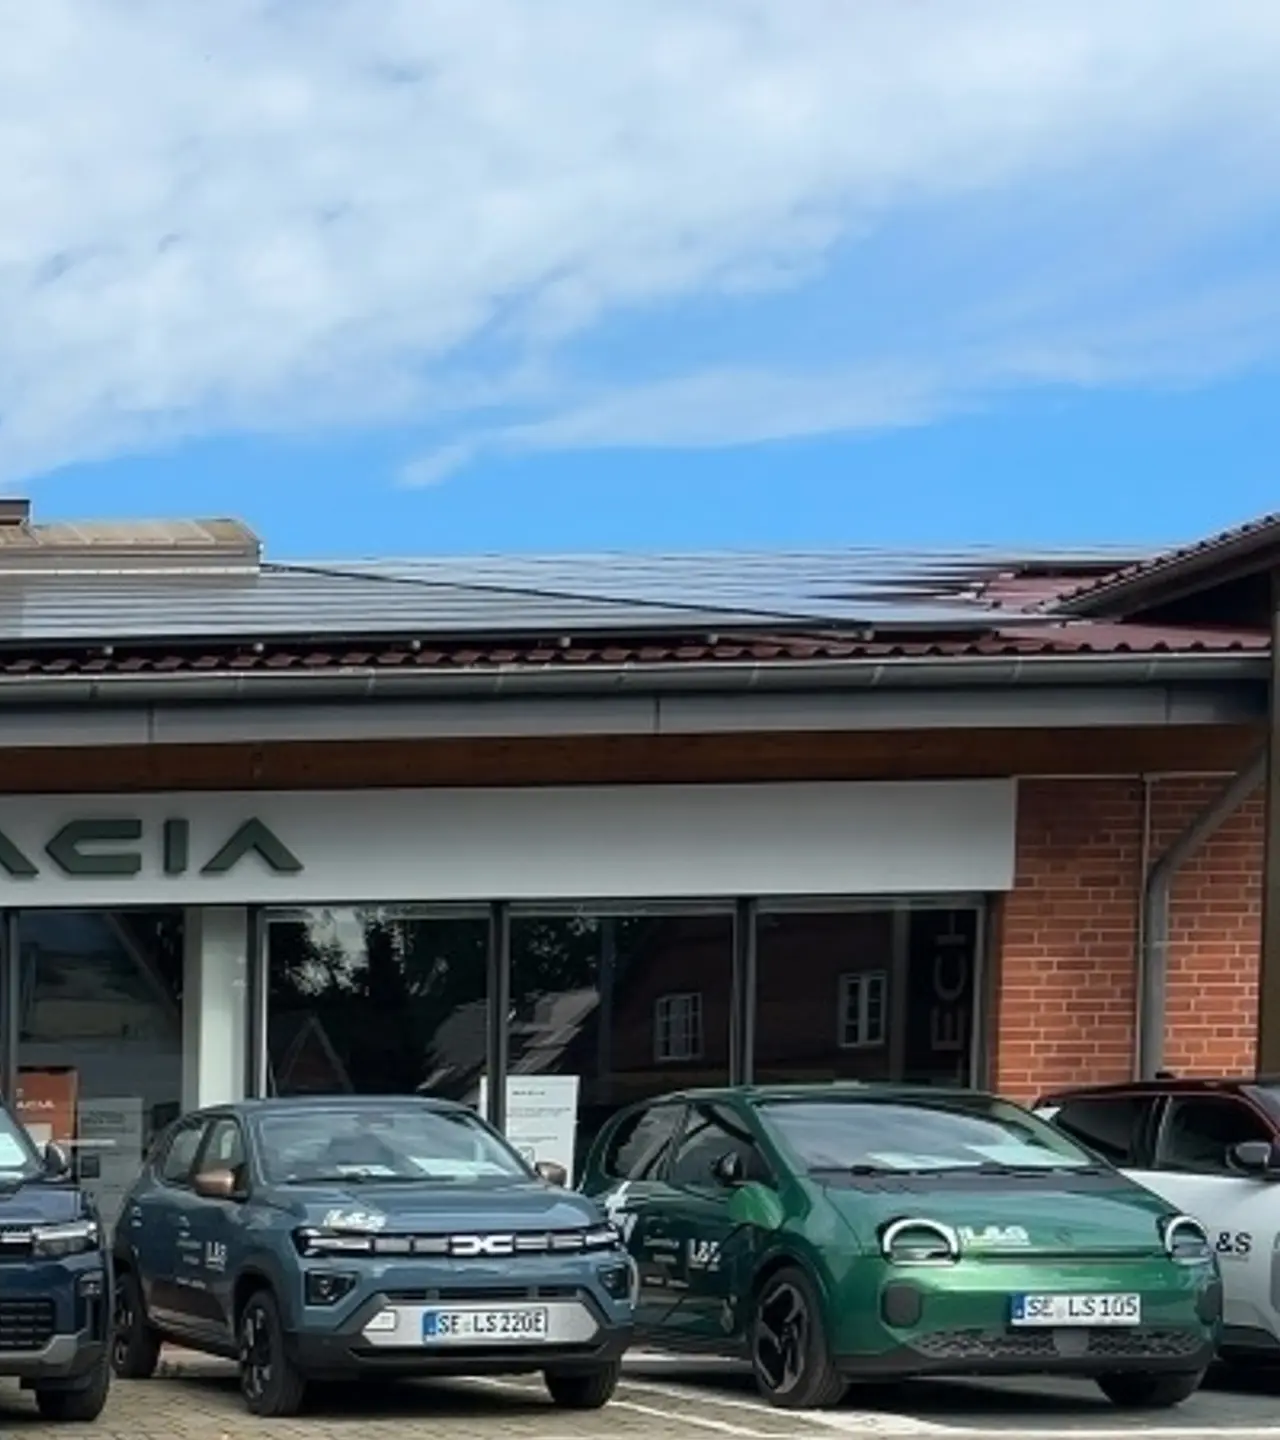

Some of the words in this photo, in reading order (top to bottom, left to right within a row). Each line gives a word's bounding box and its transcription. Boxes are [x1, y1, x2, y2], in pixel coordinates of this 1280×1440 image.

[1215, 1231, 1252, 1254] &S
[1026, 1297, 1054, 1317] SE
[1068, 1297, 1096, 1317] LS
[1098, 1295, 1138, 1317] 105
[438, 1314, 461, 1335] SE
[473, 1314, 498, 1333] LS
